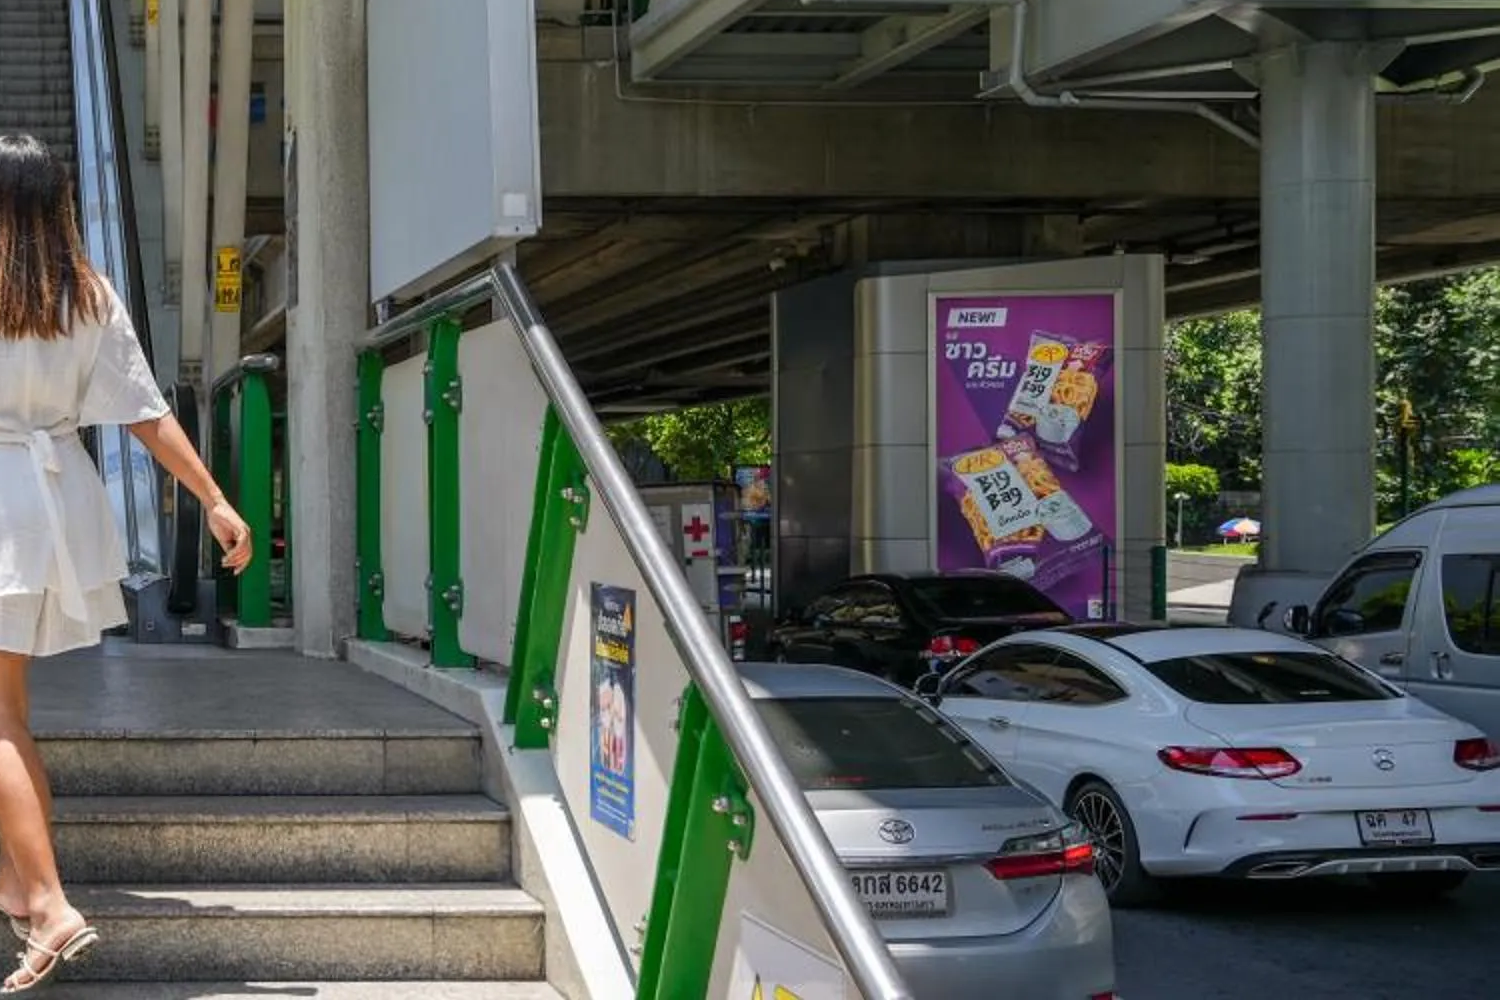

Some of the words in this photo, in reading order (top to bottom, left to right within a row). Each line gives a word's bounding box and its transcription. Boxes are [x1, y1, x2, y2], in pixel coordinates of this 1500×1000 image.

[957, 311, 997, 324] NEW!
[967, 354, 1017, 379] ครีม
[975, 469, 1011, 494] Big
[986, 488, 1023, 511] Bag
[895, 874, 943, 894] 6642
